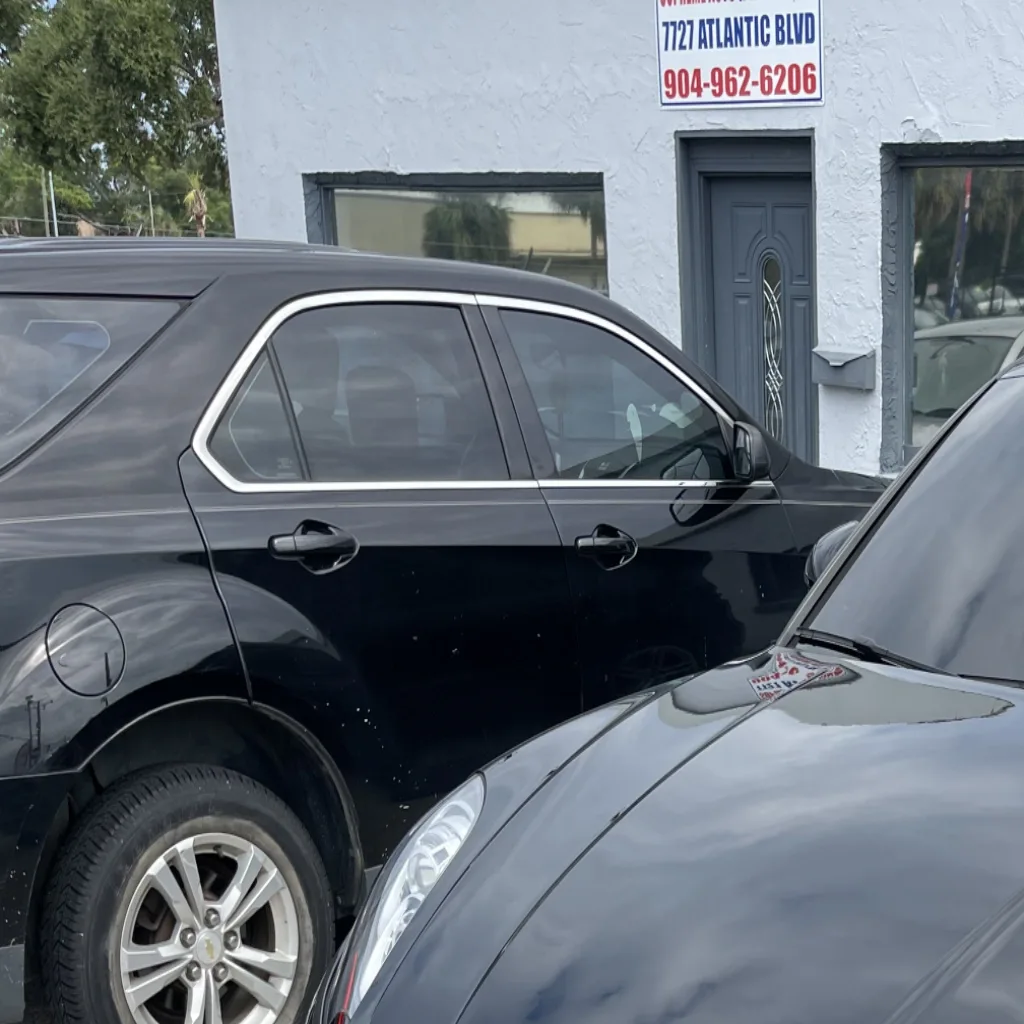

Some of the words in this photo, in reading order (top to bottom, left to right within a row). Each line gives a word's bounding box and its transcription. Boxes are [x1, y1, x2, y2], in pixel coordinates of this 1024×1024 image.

[662, 20, 694, 51] 7727
[698, 15, 771, 50] ATLANTIC
[775, 12, 815, 45] BLVD
[664, 62, 817, 99] 904-962-6206
